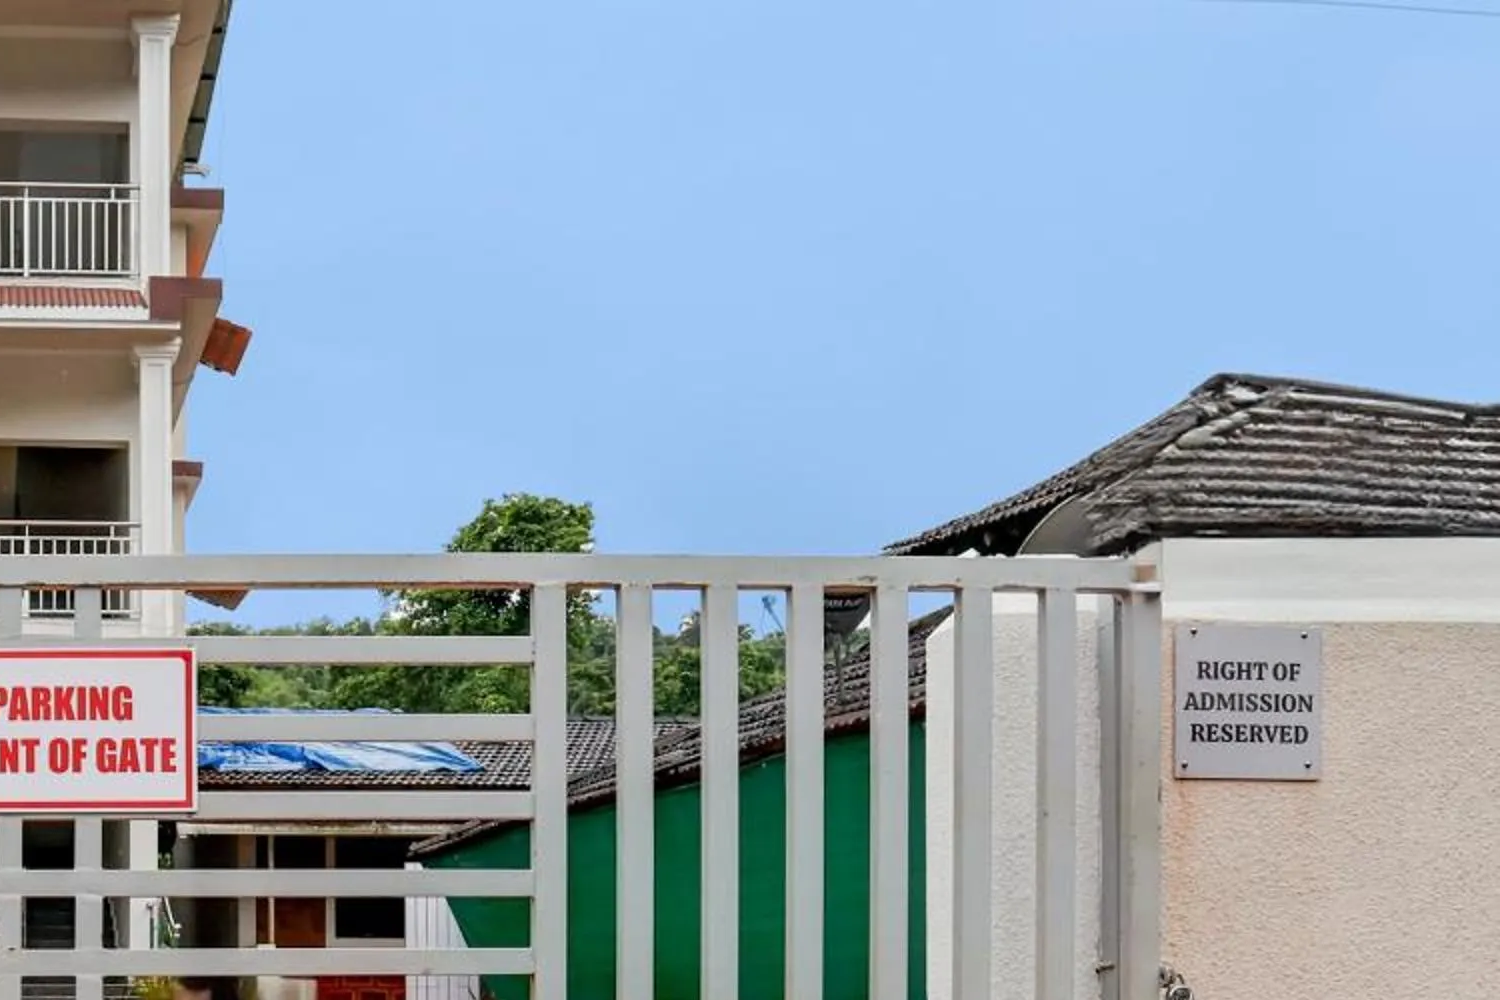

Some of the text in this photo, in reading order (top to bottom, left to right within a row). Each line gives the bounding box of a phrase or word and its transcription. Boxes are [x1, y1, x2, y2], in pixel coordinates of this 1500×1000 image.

[1197, 660, 1301, 682] RIGHT OF
[1183, 691, 1313, 713] ADMISSION
[1190, 723, 1309, 745] RESERVED
[48, 737, 88, 774] OF
[95, 737, 177, 774] GATE
